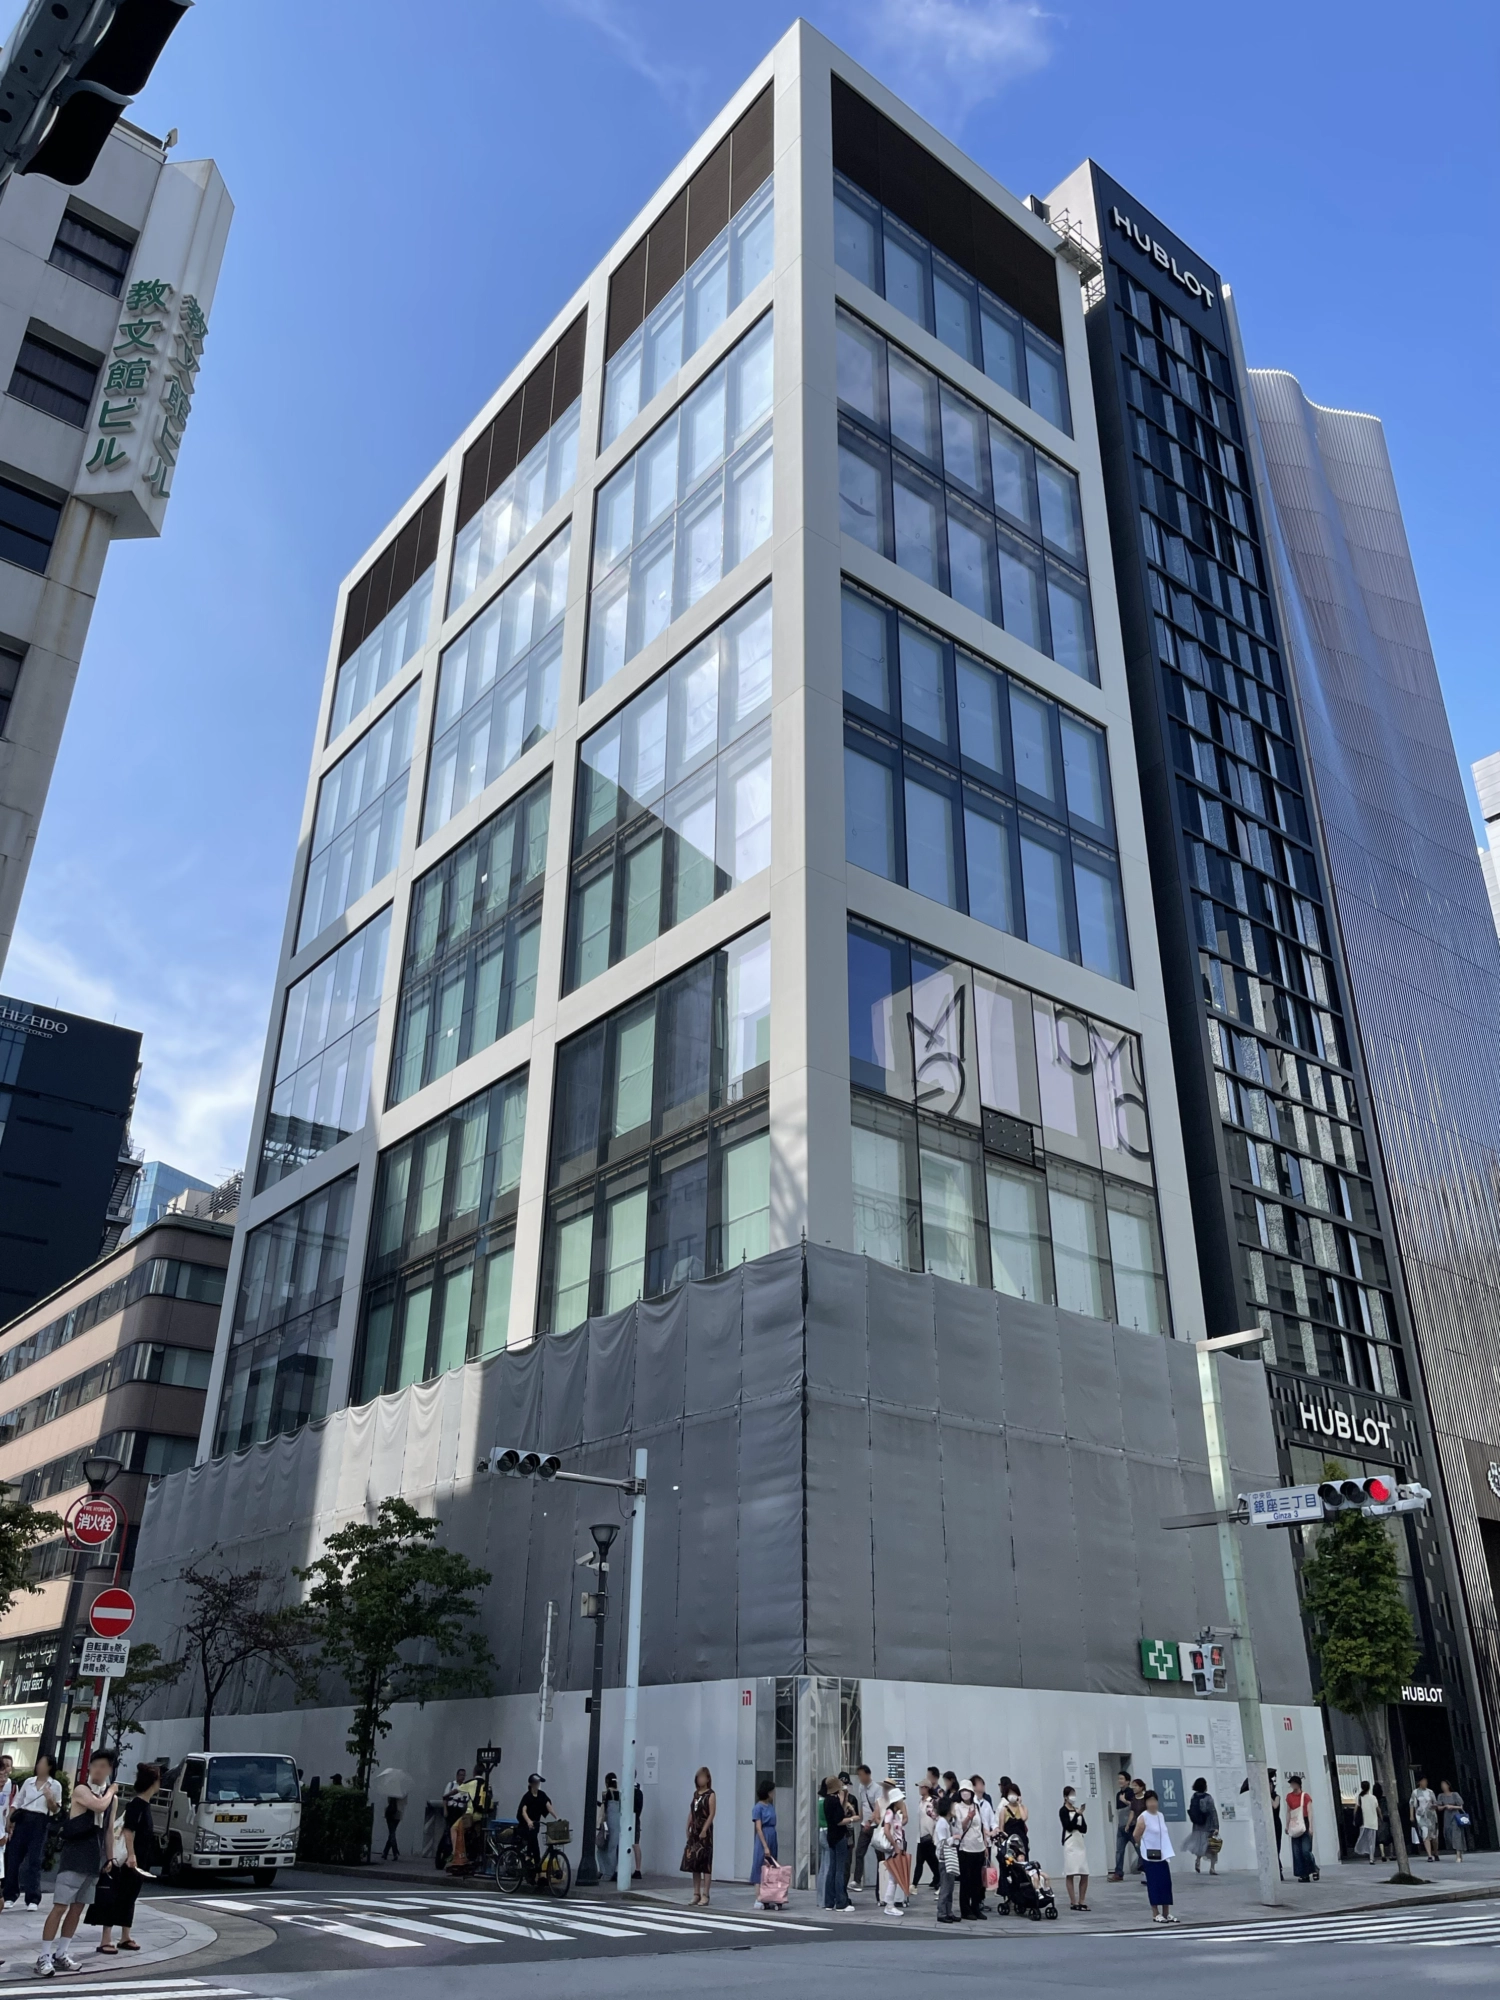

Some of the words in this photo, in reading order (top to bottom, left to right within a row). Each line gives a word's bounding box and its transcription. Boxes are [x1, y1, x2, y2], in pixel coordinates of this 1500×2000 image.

[1113, 205, 1214, 308] HUBLOT
[86, 278, 171, 471] 教文館ビル
[148, 294, 209, 499] 教文館ビル
[1299, 1401, 1391, 1449] HUBLOT
[1252, 1491, 1272, 1500] 中央区
[1253, 1493, 1317, 1513] 銀座三丁目
[77, 1513, 113, 1532] 消火栓
[1273, 1512, 1292, 1520] Ginza
[1293, 1510, 1299, 1518] 3
[86, 1641, 128, 1653] 自転車を除く
[82, 1663, 110, 1673] 時間を除く
[1401, 1685, 1443, 1703] HUBLOT
[12, 1717, 30, 1735] BASE
